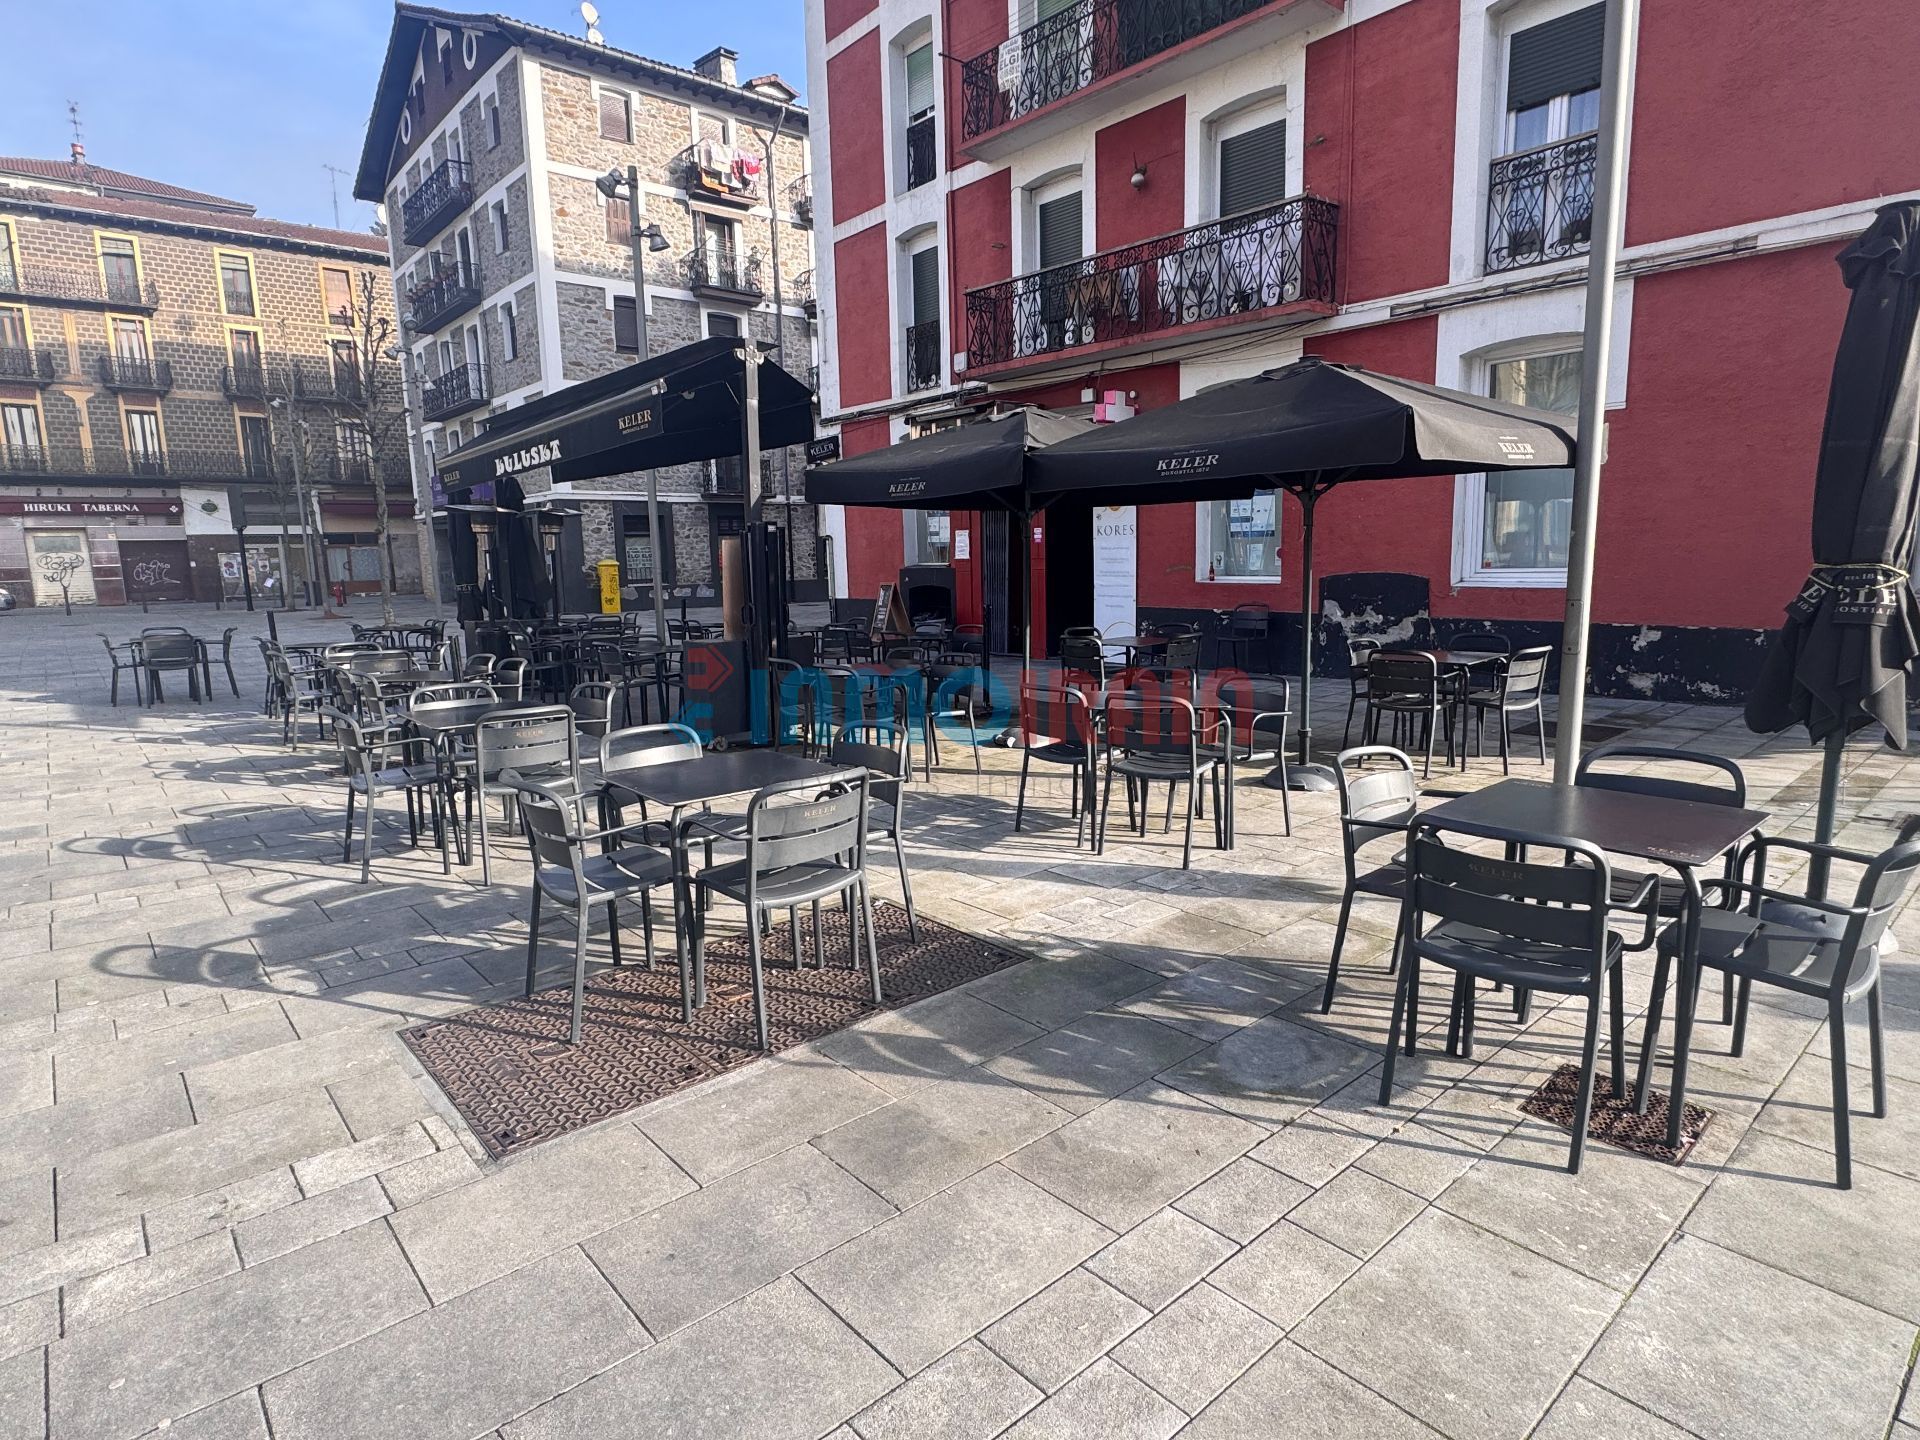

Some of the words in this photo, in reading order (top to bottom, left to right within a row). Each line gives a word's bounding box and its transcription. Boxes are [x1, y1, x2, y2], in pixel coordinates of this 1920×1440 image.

[999, 53, 1019, 70] ELGI
[617, 409, 652, 430] KELER
[810, 443, 834, 456] KELER
[1156, 454, 1219, 471] KELER
[889, 481, 926, 493] KELER
[24, 503, 71, 512] HIRUKI
[82, 503, 140, 512] TABERNA
[1096, 524, 1135, 536] KORES
